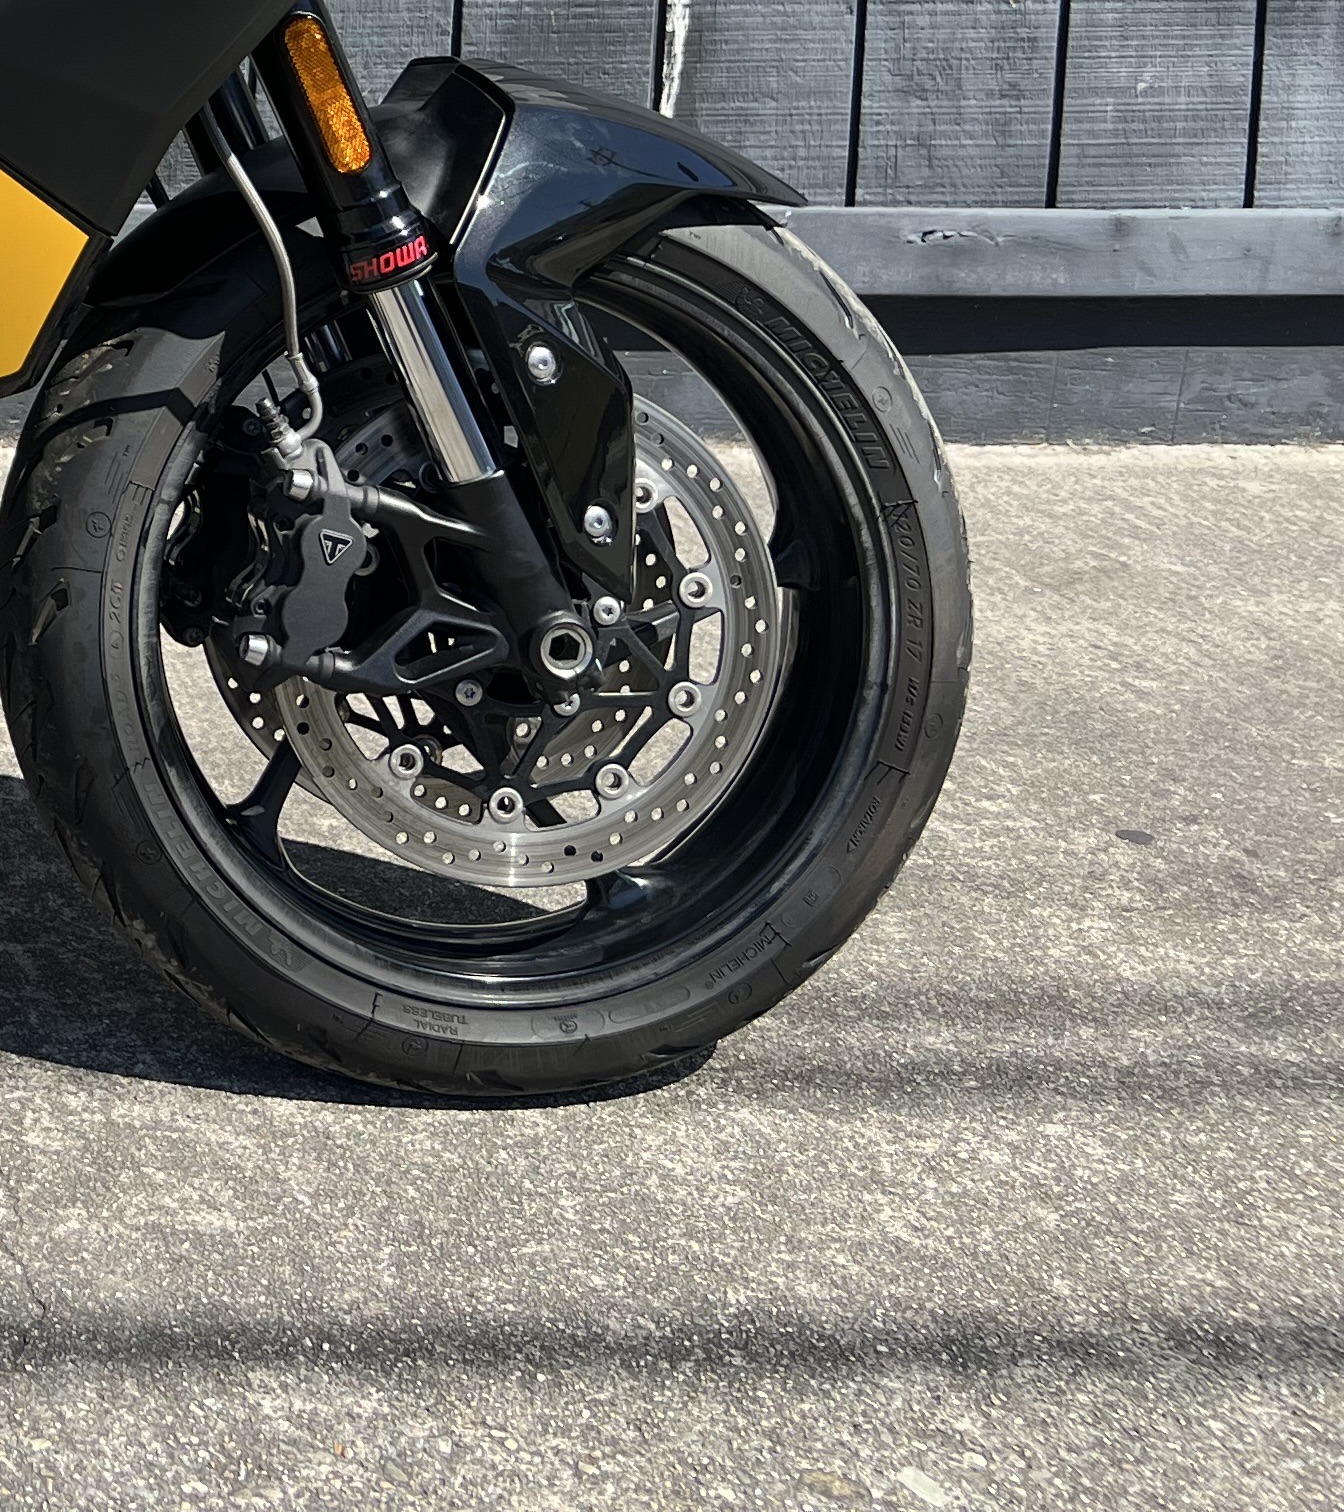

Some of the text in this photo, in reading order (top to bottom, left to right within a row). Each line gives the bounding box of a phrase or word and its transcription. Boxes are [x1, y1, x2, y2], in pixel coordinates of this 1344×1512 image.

[349, 235, 429, 281] SHOWA
[765, 316, 890, 470] MICHELIN
[904, 639, 923, 664] 17
[143, 783, 262, 937] MICHELIN
[402, 1004, 469, 1025] TUBELESS
[412, 1019, 459, 1036] RADIAL
